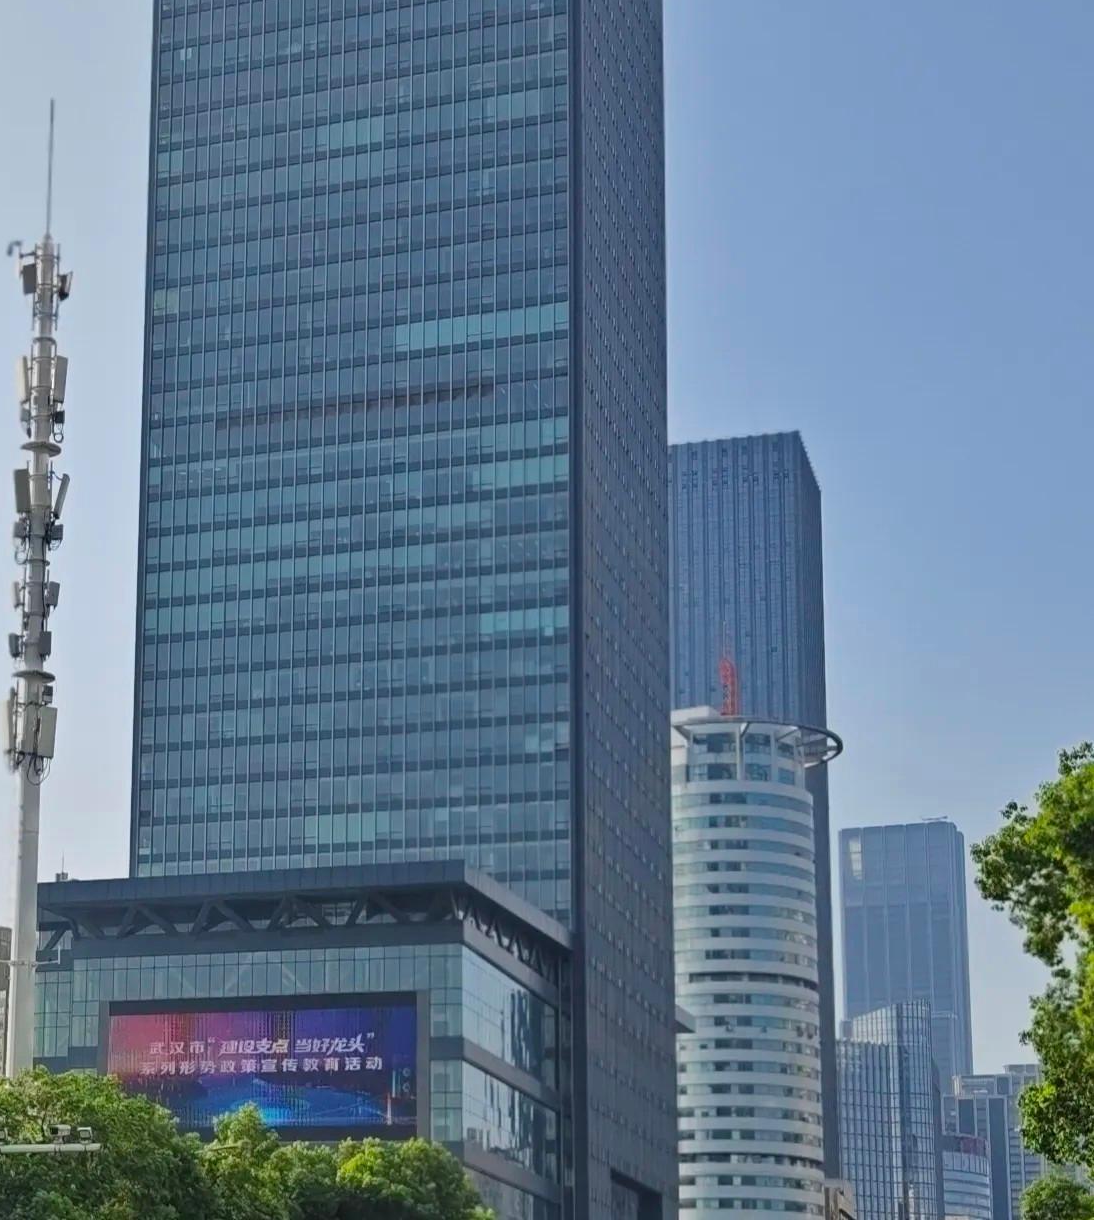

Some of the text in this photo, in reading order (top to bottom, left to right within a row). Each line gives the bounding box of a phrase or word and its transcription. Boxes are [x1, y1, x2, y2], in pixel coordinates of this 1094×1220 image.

[140, 1057, 383, 1075] 系列形势政策宣传教育活动
